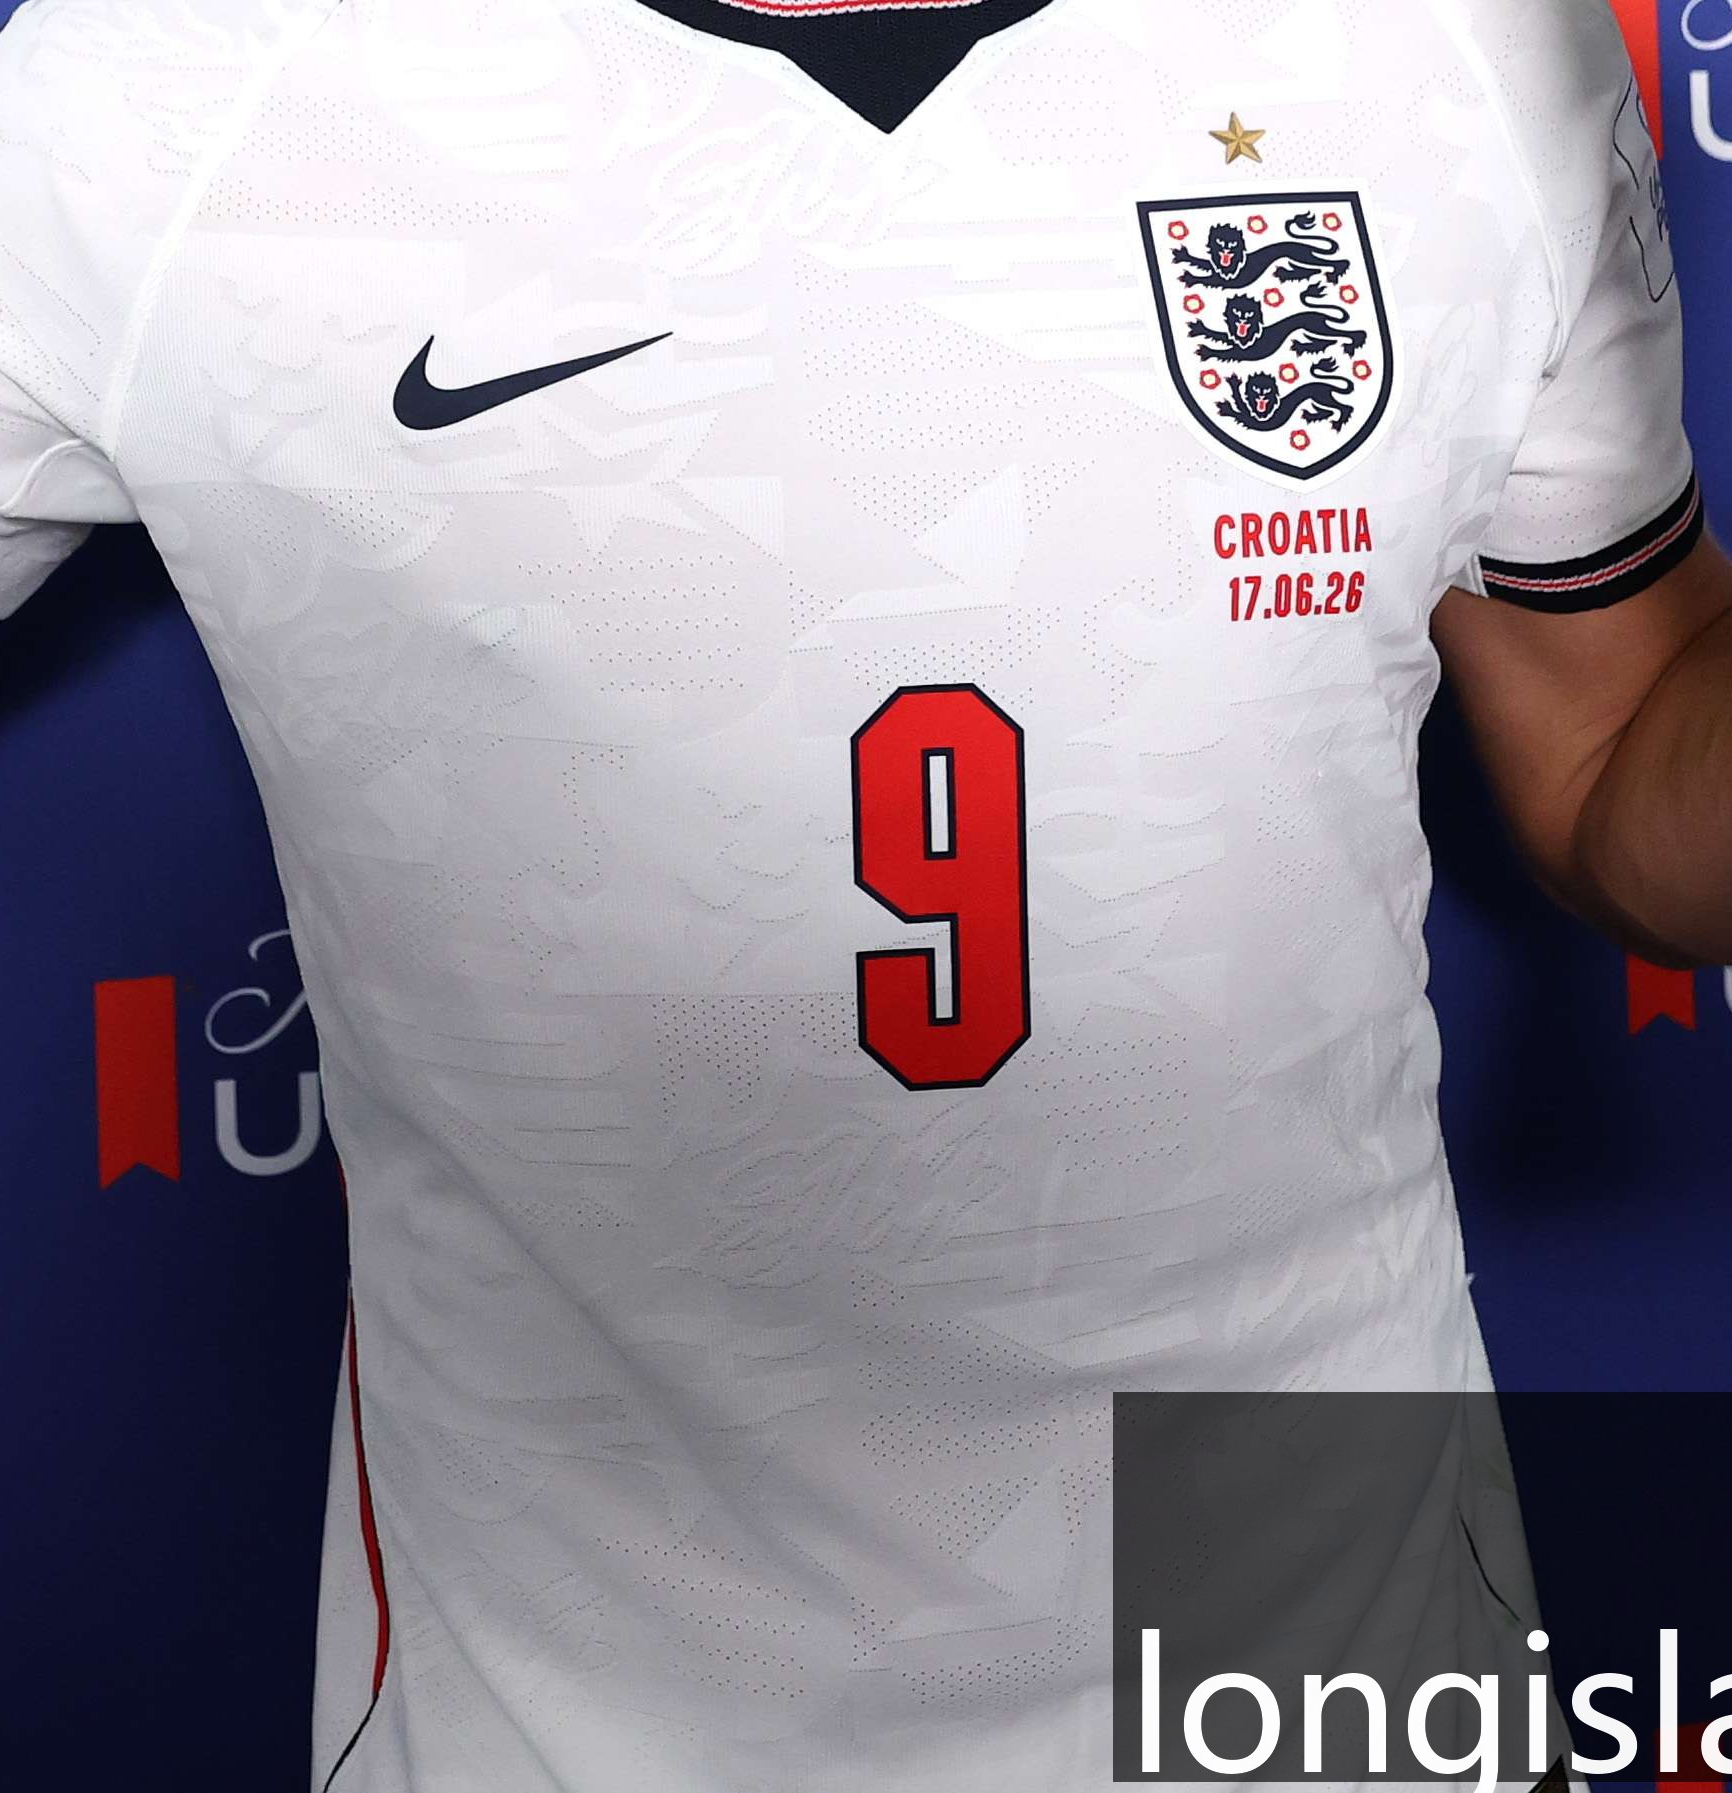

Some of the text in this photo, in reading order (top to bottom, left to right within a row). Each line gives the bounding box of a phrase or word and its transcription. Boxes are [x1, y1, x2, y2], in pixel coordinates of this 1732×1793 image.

[1213, 507, 1372, 559] CROATIA
[1228, 571, 1365, 621] 17.06.26
[850, 683, 1031, 1091] 9
